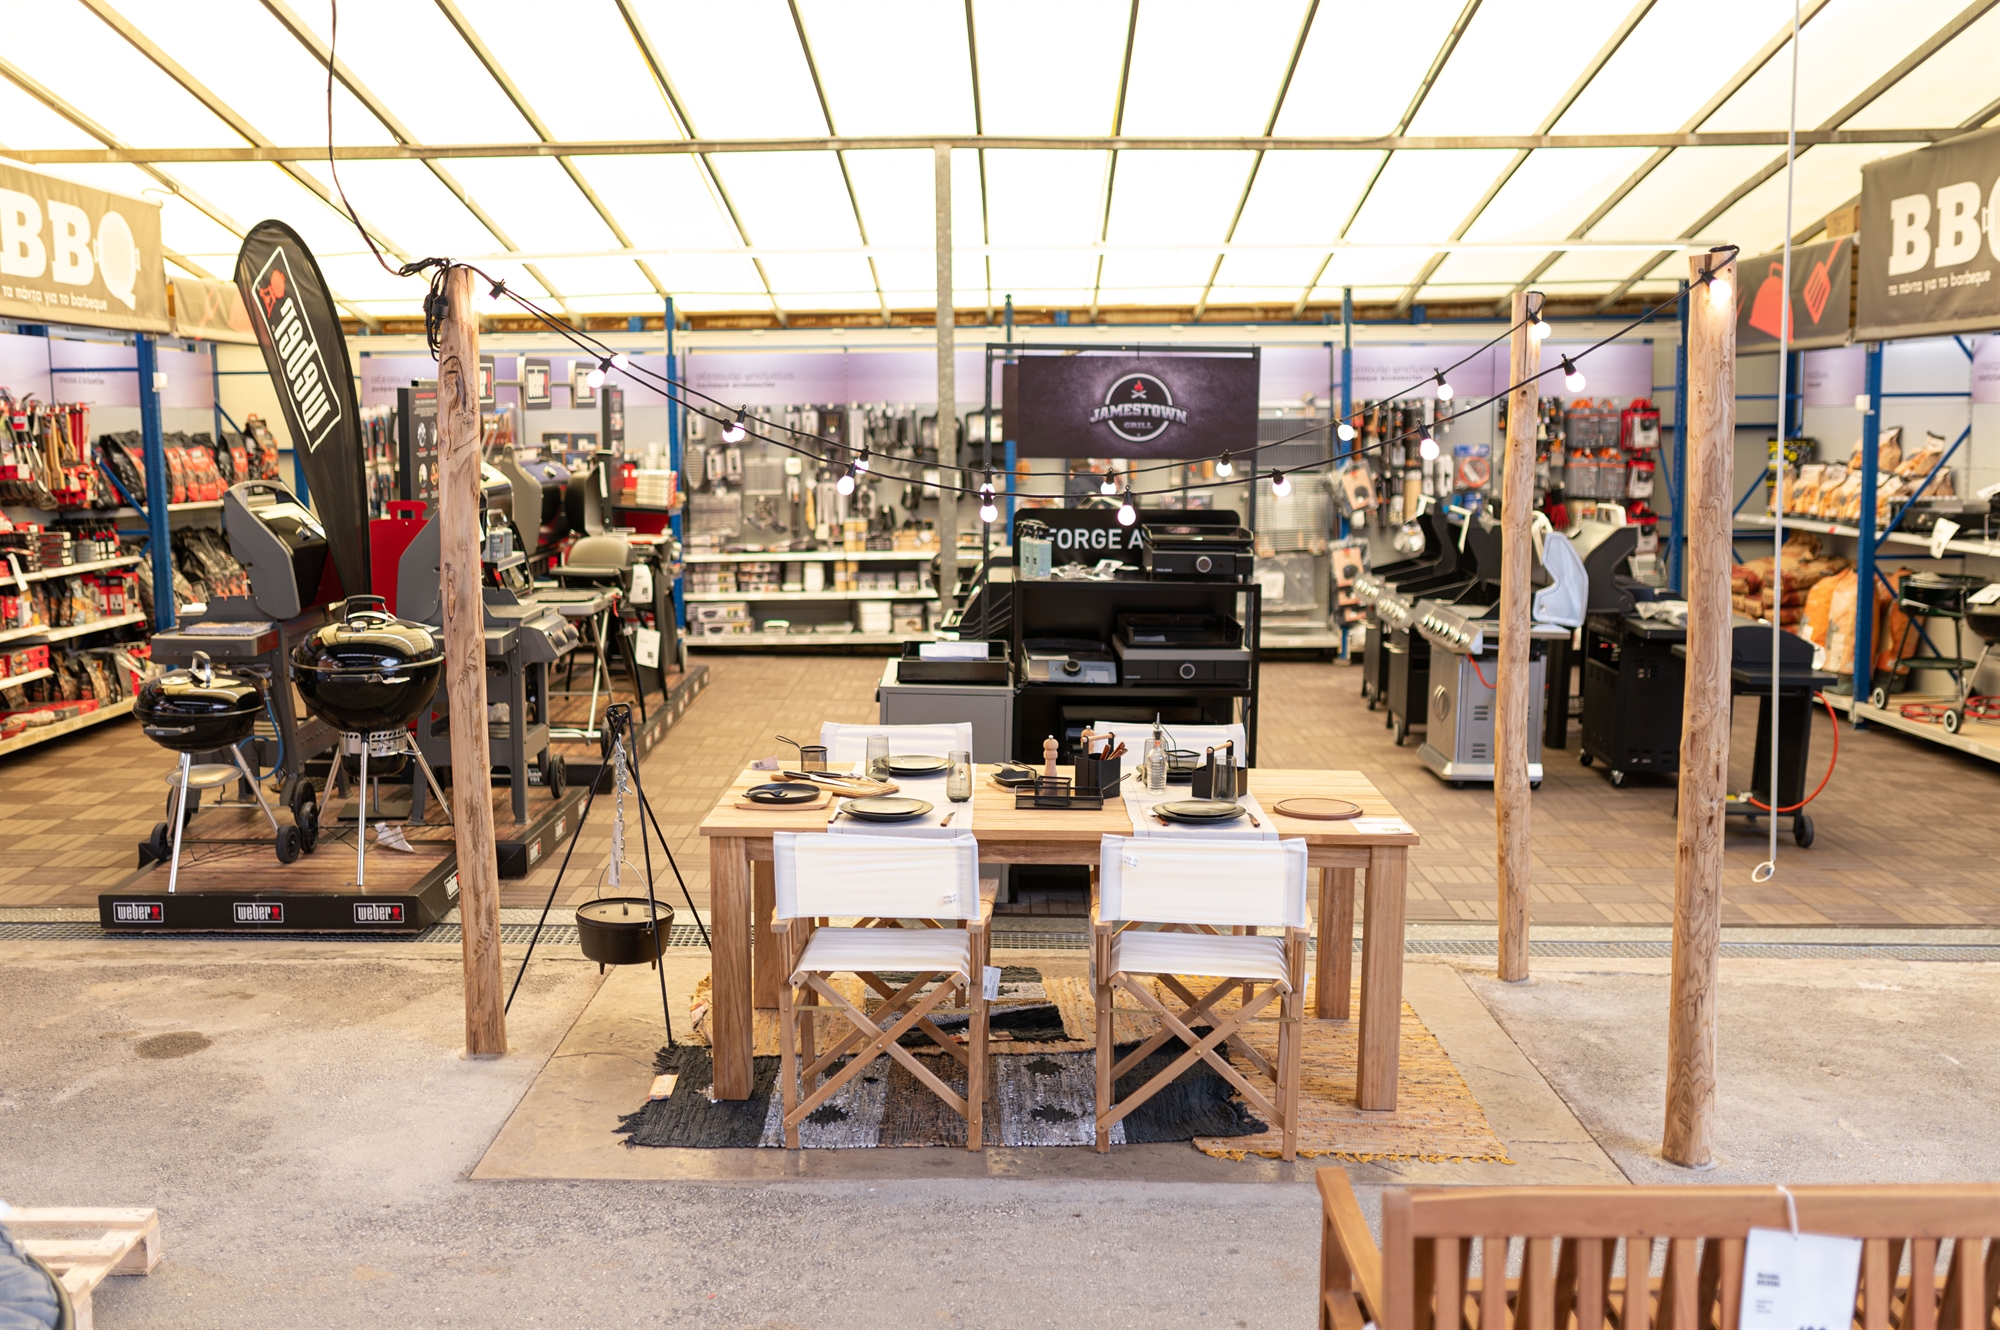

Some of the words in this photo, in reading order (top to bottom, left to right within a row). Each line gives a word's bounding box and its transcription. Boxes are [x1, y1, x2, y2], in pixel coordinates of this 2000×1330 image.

[1888, 175, 2000, 277] BB
[2, 286, 14, 299] τα
[15, 285, 43, 302] πάντα
[43, 292, 59, 308] για
[59, 293, 71, 306] το
[71, 291, 109, 314] barbeque
[1090, 402, 1188, 425] JAMESTOWN
[1123, 421, 1154, 430] GRILL
[117, 903, 151, 920] weber
[237, 903, 271, 920] weber
[357, 904, 391, 921] weber
